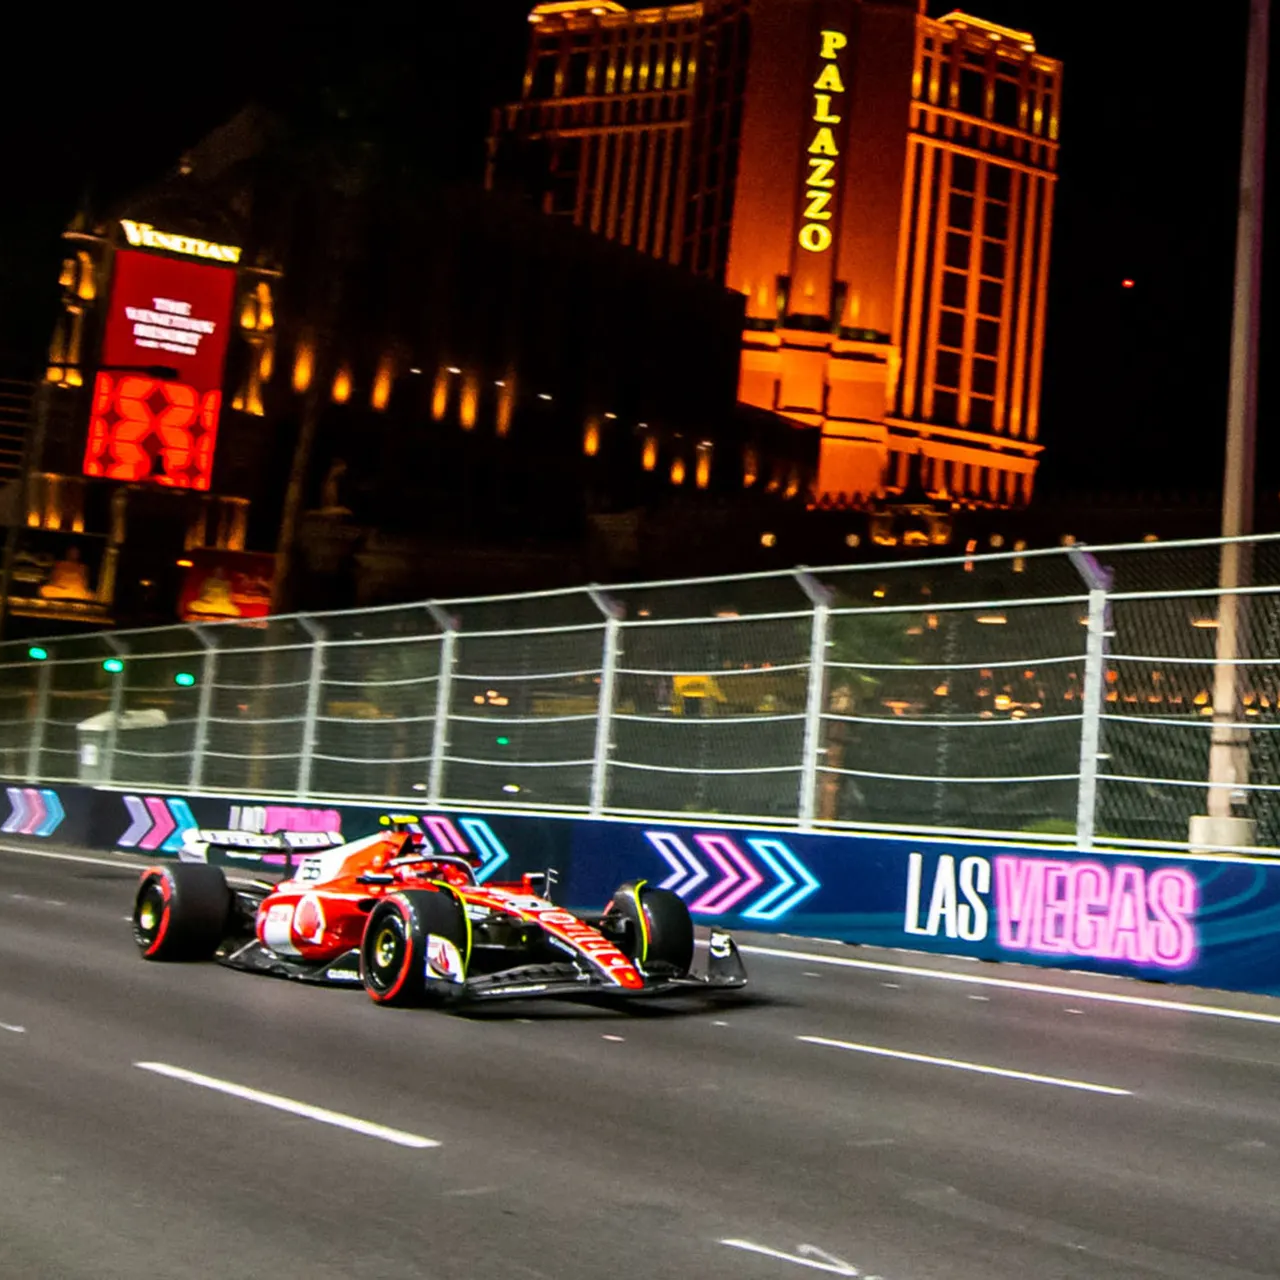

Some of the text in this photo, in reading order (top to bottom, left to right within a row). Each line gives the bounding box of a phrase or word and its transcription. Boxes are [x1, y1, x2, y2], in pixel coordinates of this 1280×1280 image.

[798, 30, 848, 253] PALAZZO
[120, 219, 242, 263] VENETIAN
[904, 852, 1199, 968] LAS VEGAS
